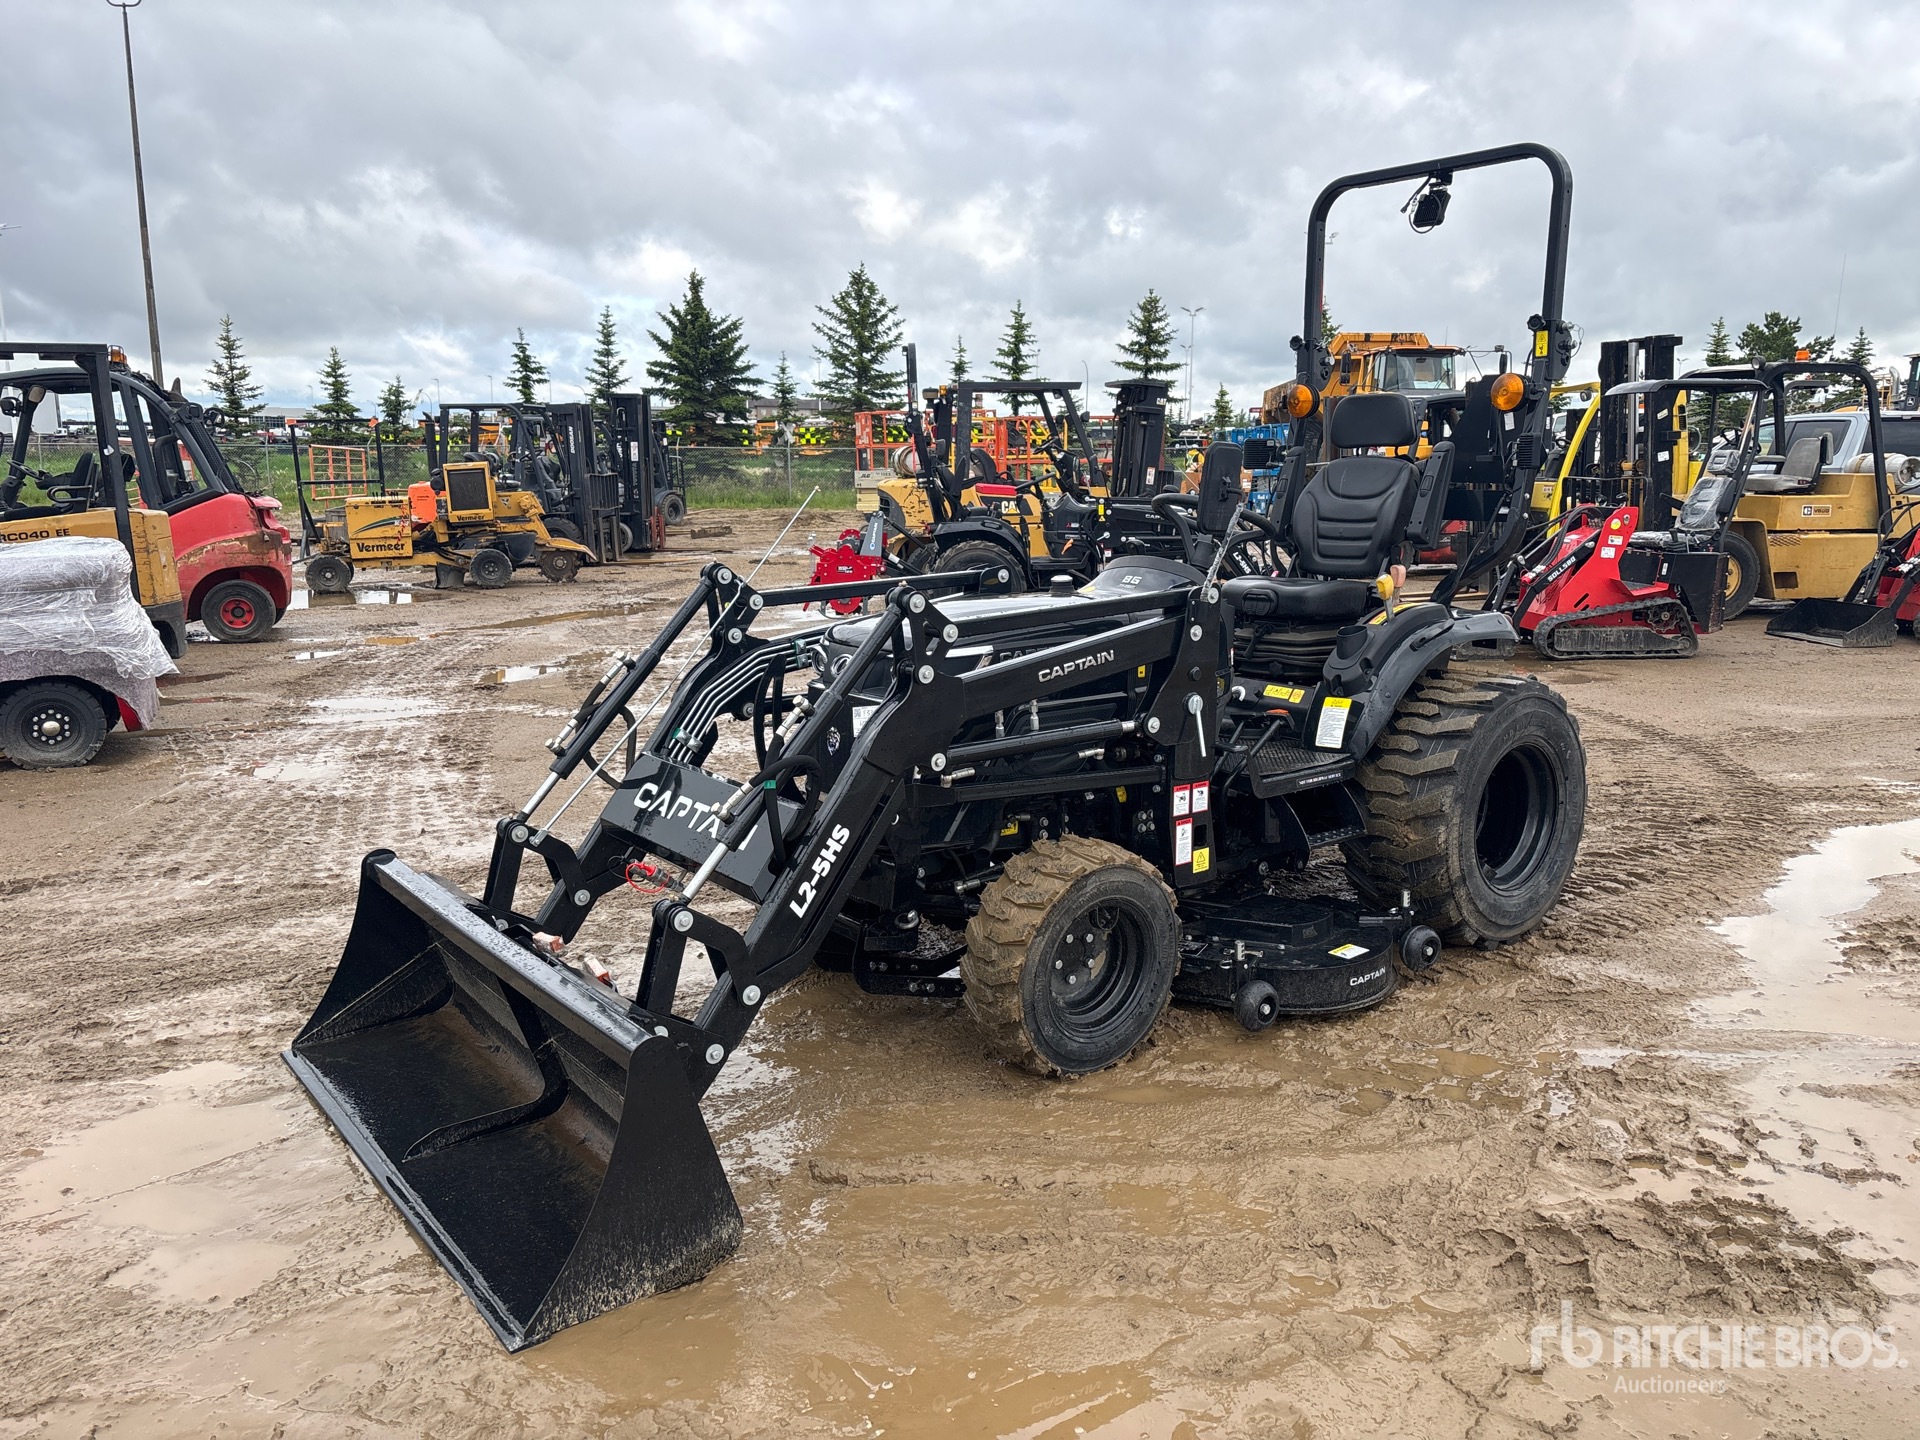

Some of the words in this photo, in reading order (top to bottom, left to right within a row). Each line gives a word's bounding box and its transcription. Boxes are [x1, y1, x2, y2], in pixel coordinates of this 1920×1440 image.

[1156, 397, 1167, 405] CAT
[1001, 500, 1020, 514] CA
[356, 542, 405, 552] Vermeer
[1038, 649, 1114, 682] CAPTAIN
[634, 782, 758, 850] CAPTA
[789, 823, 850, 919] L2-5HS
[1349, 966, 1386, 986] CAPTAIN
